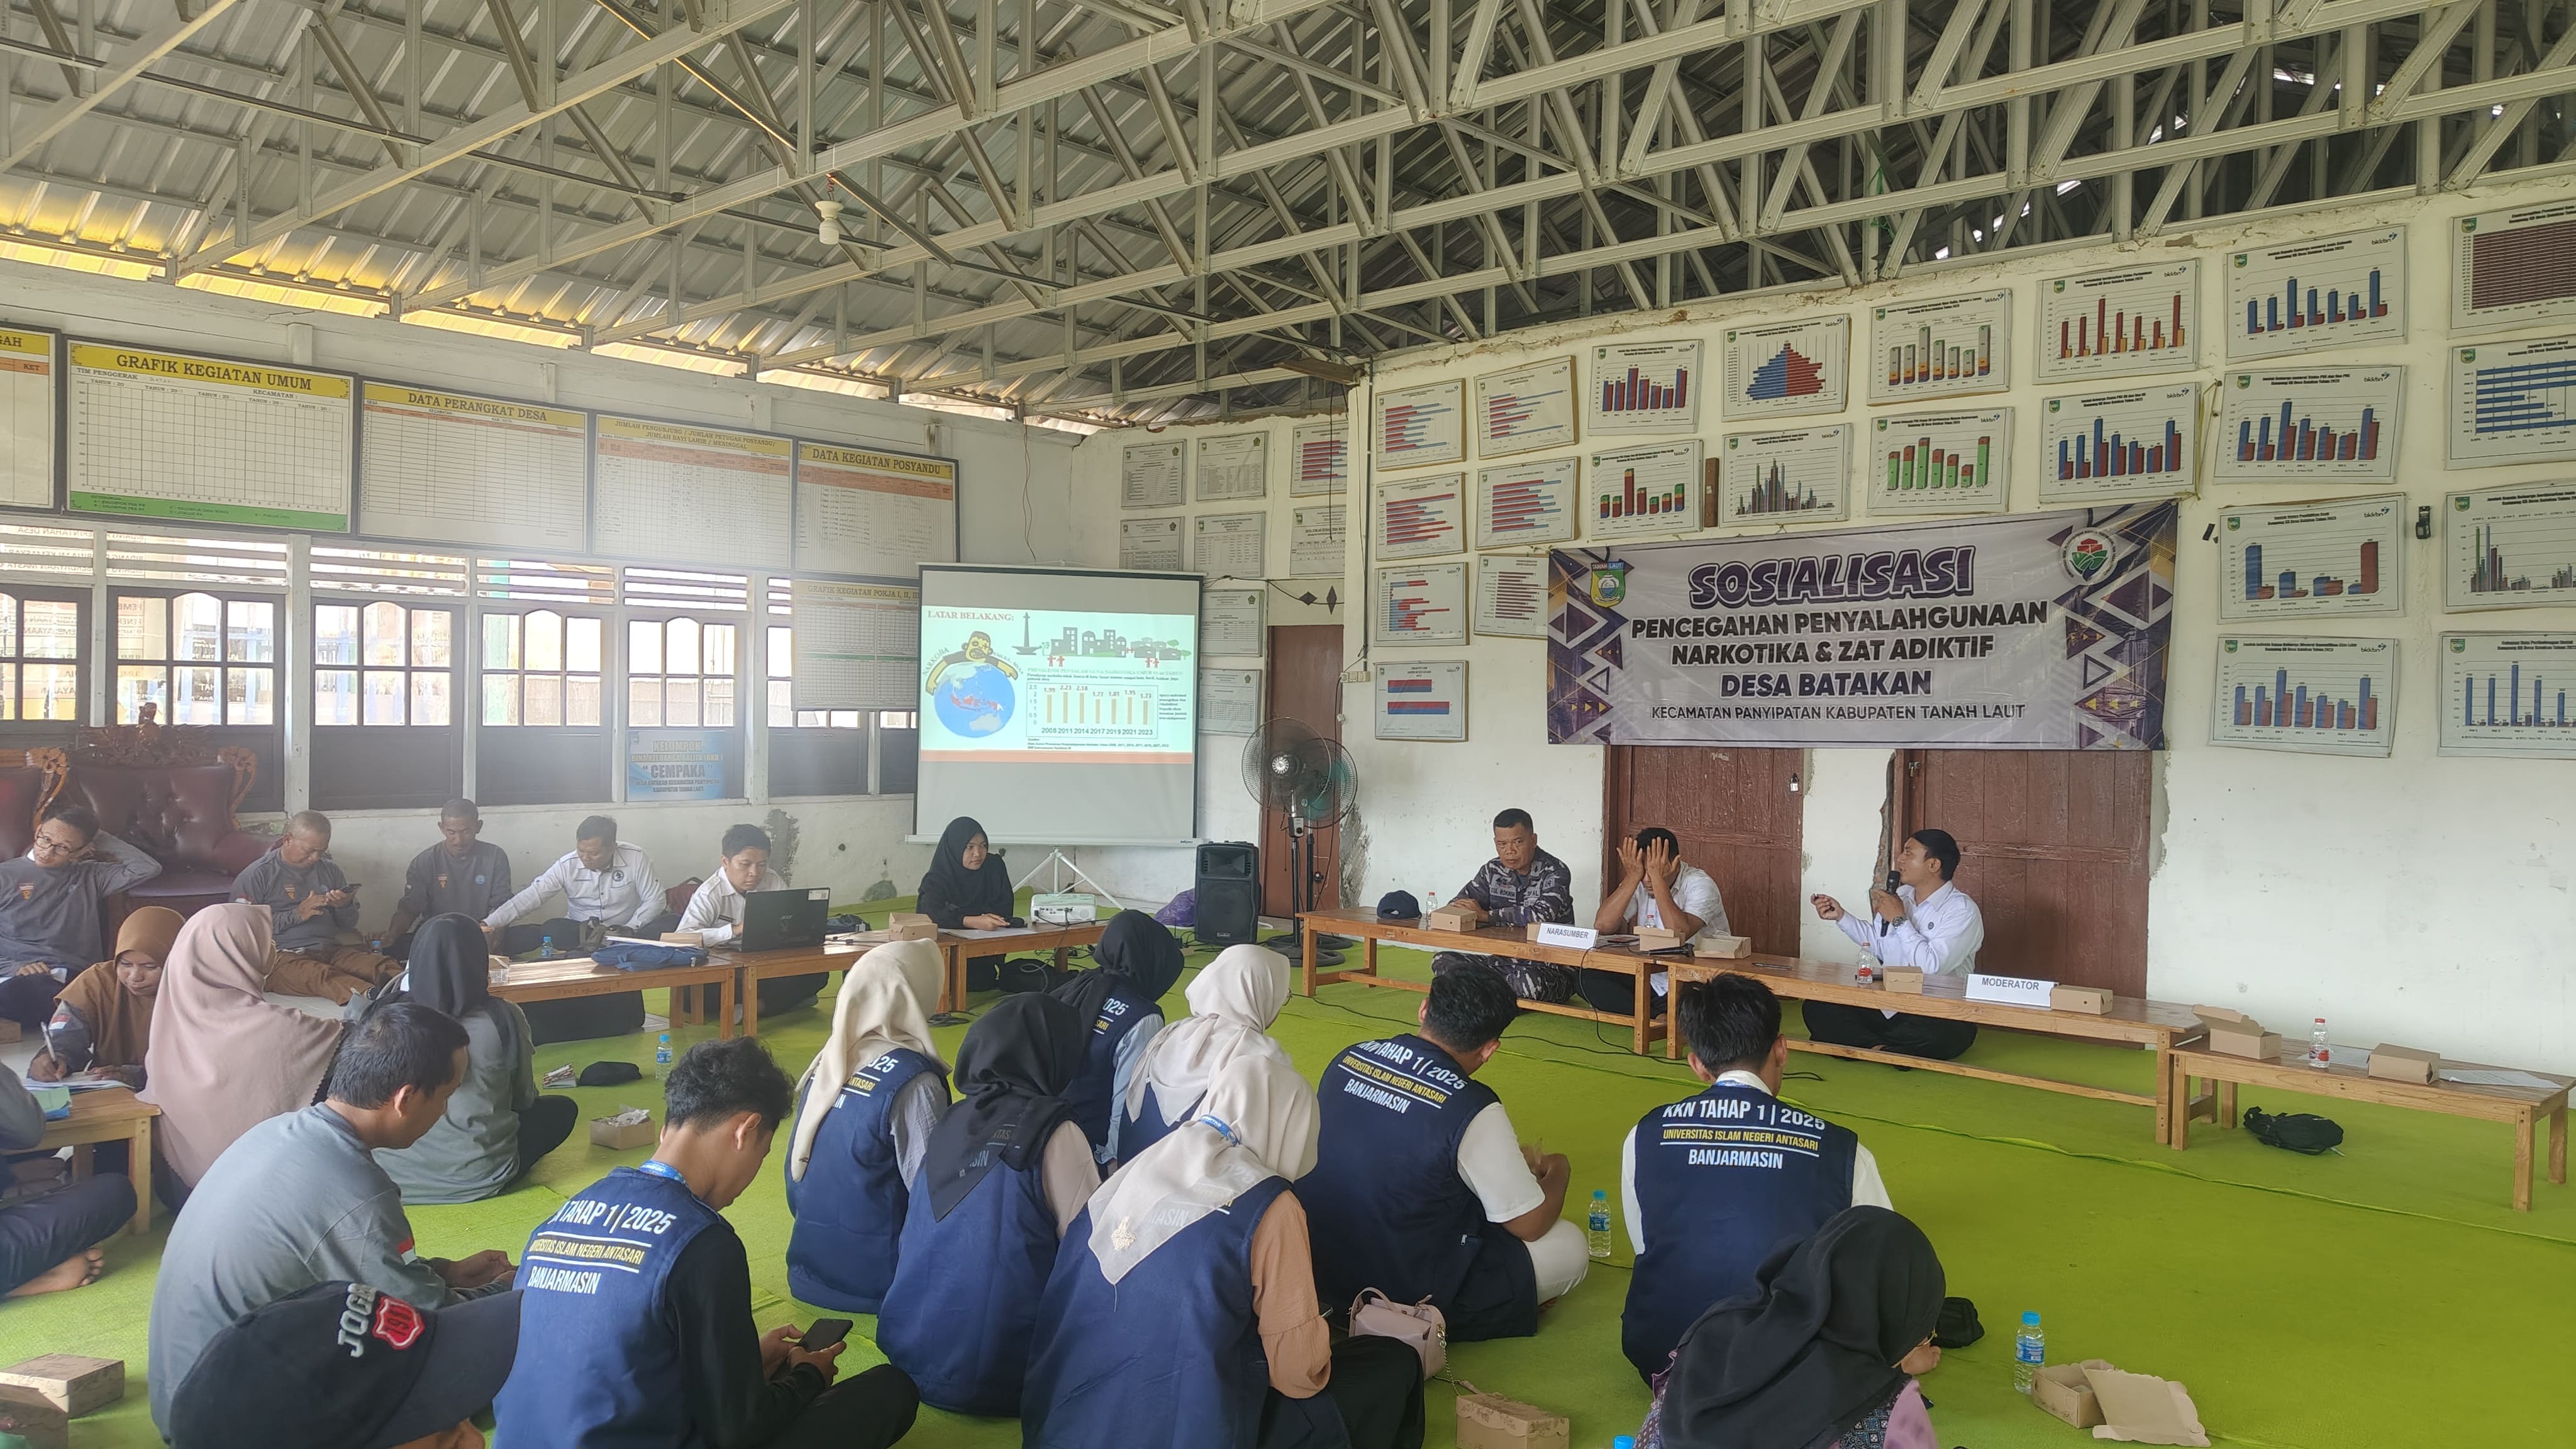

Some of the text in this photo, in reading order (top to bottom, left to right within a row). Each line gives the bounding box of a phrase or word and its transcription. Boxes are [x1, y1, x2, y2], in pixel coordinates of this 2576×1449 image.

[93, 369, 138, 380] PENGGERAK
[117, 354, 311, 391] GRAFIK KEGIATAN UMUM
[253, 389, 294, 399] KECAMATAN
[409, 393, 440, 408] DATA
[445, 397, 515, 418] PERANGKAT
[518, 409, 547, 421] DESA
[614, 421, 640, 429] JUMLAH
[642, 424, 682, 435] PENGUNJUNG
[689, 430, 713, 438] JUMLAH
[645, 431, 671, 440] JUMLAH
[713, 440, 748, 450] MENINGGAL
[813, 448, 941, 475] DATA KEGIATAN POSYANDU
[1689, 546, 1976, 609] SOSIALISASI
[808, 586, 835, 594] GRAFIK
[837, 587, 872, 596] KEGIATAN
[874, 589, 896, 597] POKJA
[928, 611, 1014, 621] LATAR BELAKANG:
[1631, 601, 2048, 638] PENCEGAHAN PENYALAHGUNAAN
[1672, 635, 1994, 665] NARKOTIKA & ZAT ADIKTIF
[1721, 670, 1931, 697] DESA BATAKAN
[1652, 704, 2025, 719] KECAMATAN PANYIPATAN KABUPATEN TANAH LAUT
[653, 740, 702, 752] KELOMPOK
[651, 765, 706, 778] CEMPAKA
[1546, 926, 1589, 940] NARASUMBER
[1982, 977, 2040, 991] MODERATOR
[1102, 998, 1129, 1016] 025
[1342, 1055, 1446, 1103] UNIVERSITAS ISLAM NEGERI ANTASARI
[1412, 1057, 1421, 1070] 1
[1426, 1066, 1468, 1090] 2025
[1344, 1079, 1411, 1114] BANJARMASIN
[1662, 1101, 1696, 1118] KKN
[1699, 1099, 1751, 1119] TAHAP
[1757, 1105, 1765, 1121] 1
[1780, 1108, 1825, 1131] 2025
[1663, 1129, 1818, 1151] UNIVERSITAS ISLAM NEGERI ANTASARI
[1688, 1149, 1784, 1169] BANJARMASIN
[561, 1200, 607, 1224] TAHAP
[603, 1204, 619, 1226] 1
[621, 1206, 677, 1235] 2025
[554, 1241, 577, 1254] ISLAM
[576, 1243, 604, 1258] NEGERI
[603, 1245, 646, 1265] ANTASARI
[527, 1266, 601, 1294] BANJARMASIN
